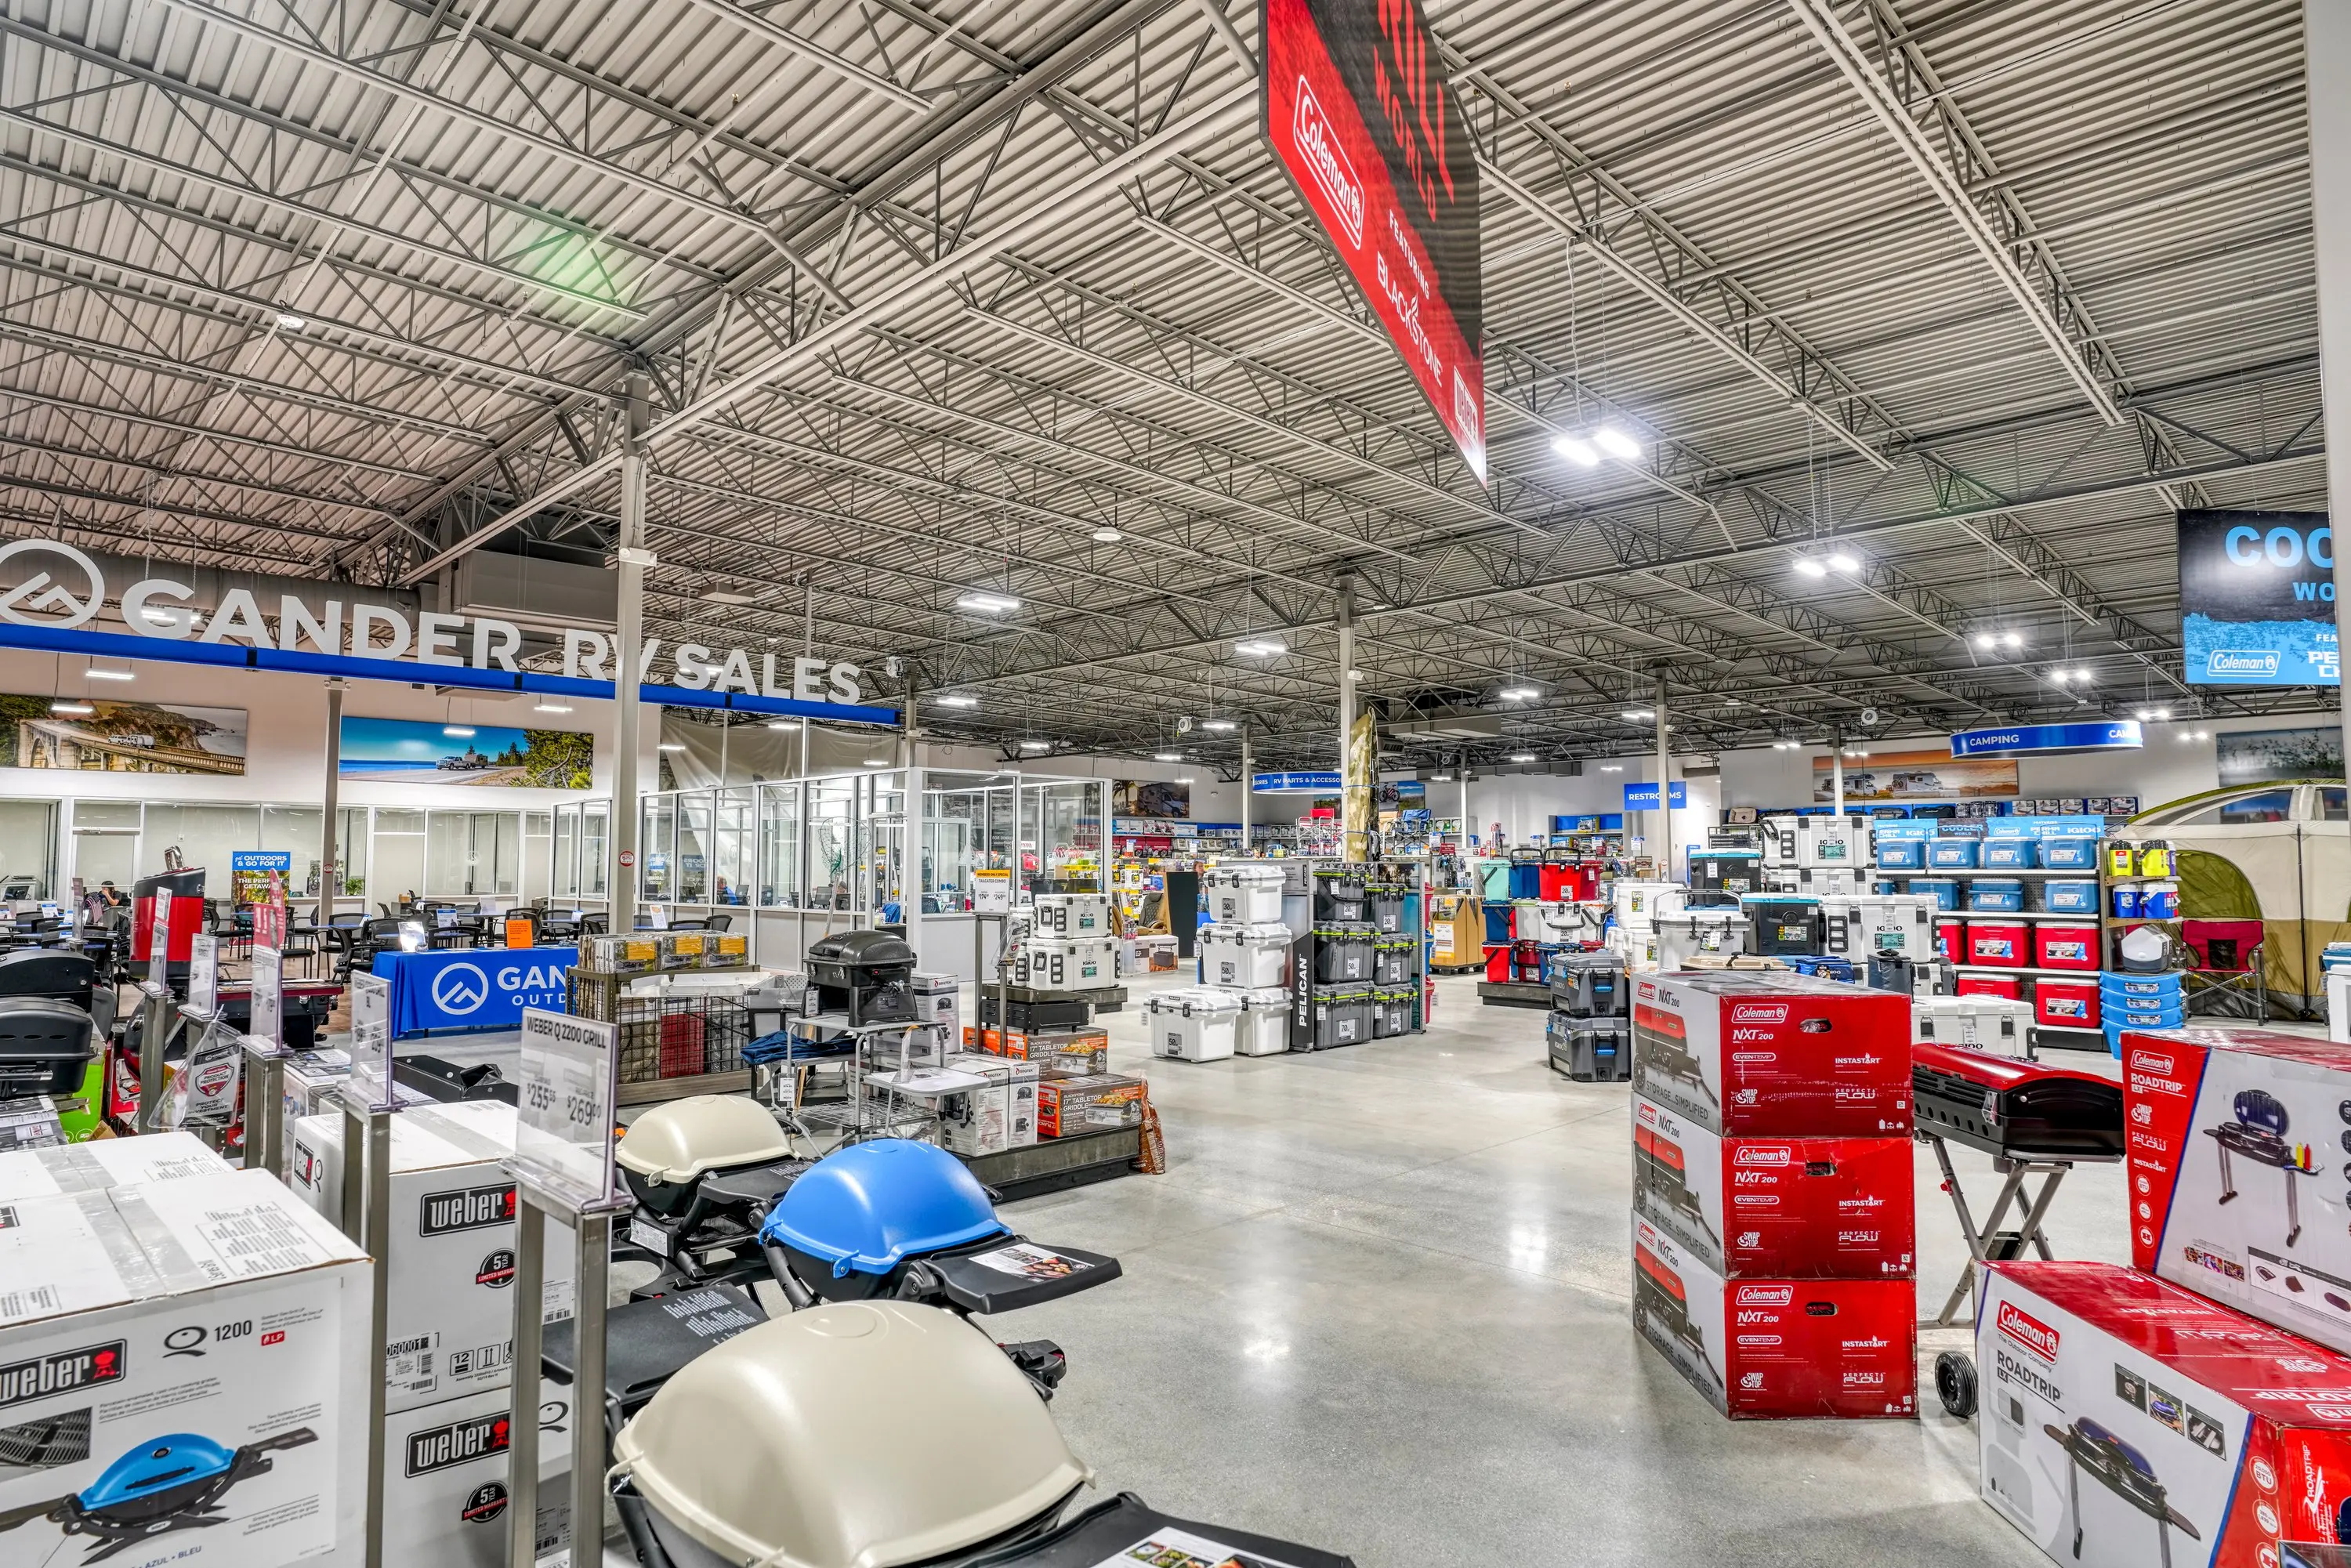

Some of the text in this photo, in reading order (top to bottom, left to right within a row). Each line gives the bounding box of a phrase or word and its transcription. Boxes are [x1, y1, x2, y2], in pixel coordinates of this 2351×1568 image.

[1374, 44, 1436, 222] WORLD
[1302, 95, 1350, 212] Coleman
[1389, 208, 1429, 299] FEATURING
[1377, 251, 1443, 387] BLACKSTONE
[121, 579, 521, 672] GANDER
[673, 643, 860, 705] SALES
[2213, 654, 2264, 670] Coleman
[2308, 651, 2339, 664] PE
[1969, 734, 2020, 747] CAMPING
[1628, 791, 1682, 800] RESTROMS
[497, 965, 571, 990] GAN
[1299, 959, 1307, 1027] PELICAN
[1639, 983, 1652, 997] Coleman
[1658, 986, 1680, 1008] NXT 200
[1737, 1006, 1776, 1018] Coleman
[527, 1016, 607, 1049] WEBER Q 2200 GRILL
[1733, 1027, 1759, 1040] NXT
[2134, 1052, 2164, 1068] Coleman
[200, 1074, 229, 1084] PROTECTION
[204, 1071, 226, 1080] PRODUCT
[2131, 1073, 2183, 1092] ROADTRIP
[1072, 1095, 1103, 1103] TABLETOP
[1741, 1088, 1758, 1097] SWAP
[195, 1098, 223, 1106] PROTECT
[1640, 1104, 1652, 1121] Coleman
[1658, 1114, 1680, 1139] NXT 200
[2132, 1136, 2167, 1151] FLOW
[1739, 1149, 1779, 1161] Coleman
[2133, 1157, 2167, 1173] INSTASTART
[1735, 1169, 1762, 1183] NXT
[430, 1191, 502, 1229] weber
[1657, 1239, 1679, 1267] NXT 200
[493, 1255, 502, 1269] 5
[478, 1272, 497, 1281] LIMITED
[1741, 1288, 1780, 1301] Coleman
[1737, 1309, 1765, 1323] NXT
[214, 1320, 252, 1342] 1200
[2001, 1304, 2046, 1347] Coleman
[271, 1333, 284, 1342] LP
[454, 1353, 469, 1363] 12
[1998, 1334, 2052, 1373] The Outdoor Company
[0, 1349, 90, 1401] weber
[1746, 1372, 1763, 1381] SWAP
[1998, 1349, 2061, 1402] ROADTRIP
[1751, 1380, 1762, 1389] TOP
[416, 1424, 491, 1468] weber
[2256, 1472, 2272, 1485] BTU
[2302, 1445, 2313, 1497] ROADTRIP
[480, 1489, 489, 1504] 5
[464, 1505, 484, 1518] LIMITED
[145, 1545, 202, 1568] AZUL BLEU
